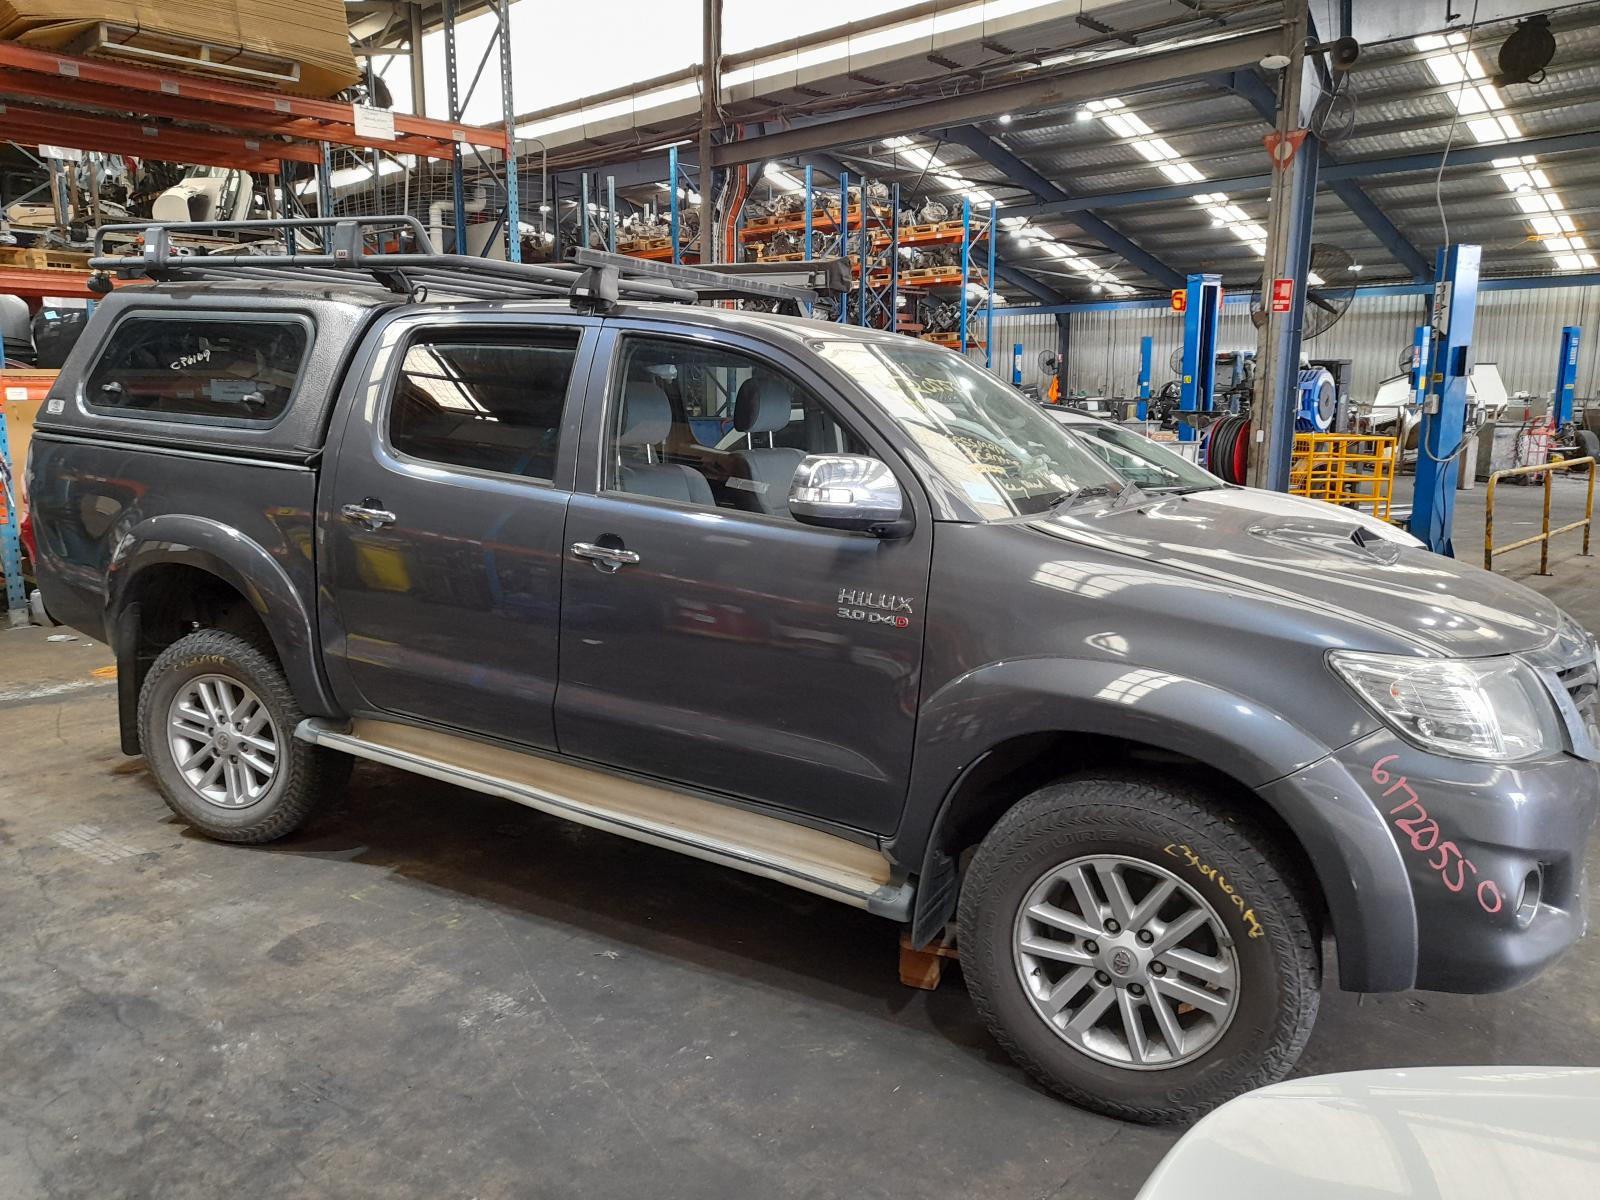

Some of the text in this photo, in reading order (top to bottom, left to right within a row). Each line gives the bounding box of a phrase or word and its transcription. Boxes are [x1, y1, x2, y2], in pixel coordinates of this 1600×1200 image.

[837, 588, 913, 613] HILUX
[837, 607, 908, 627] 3.0 D-4D
